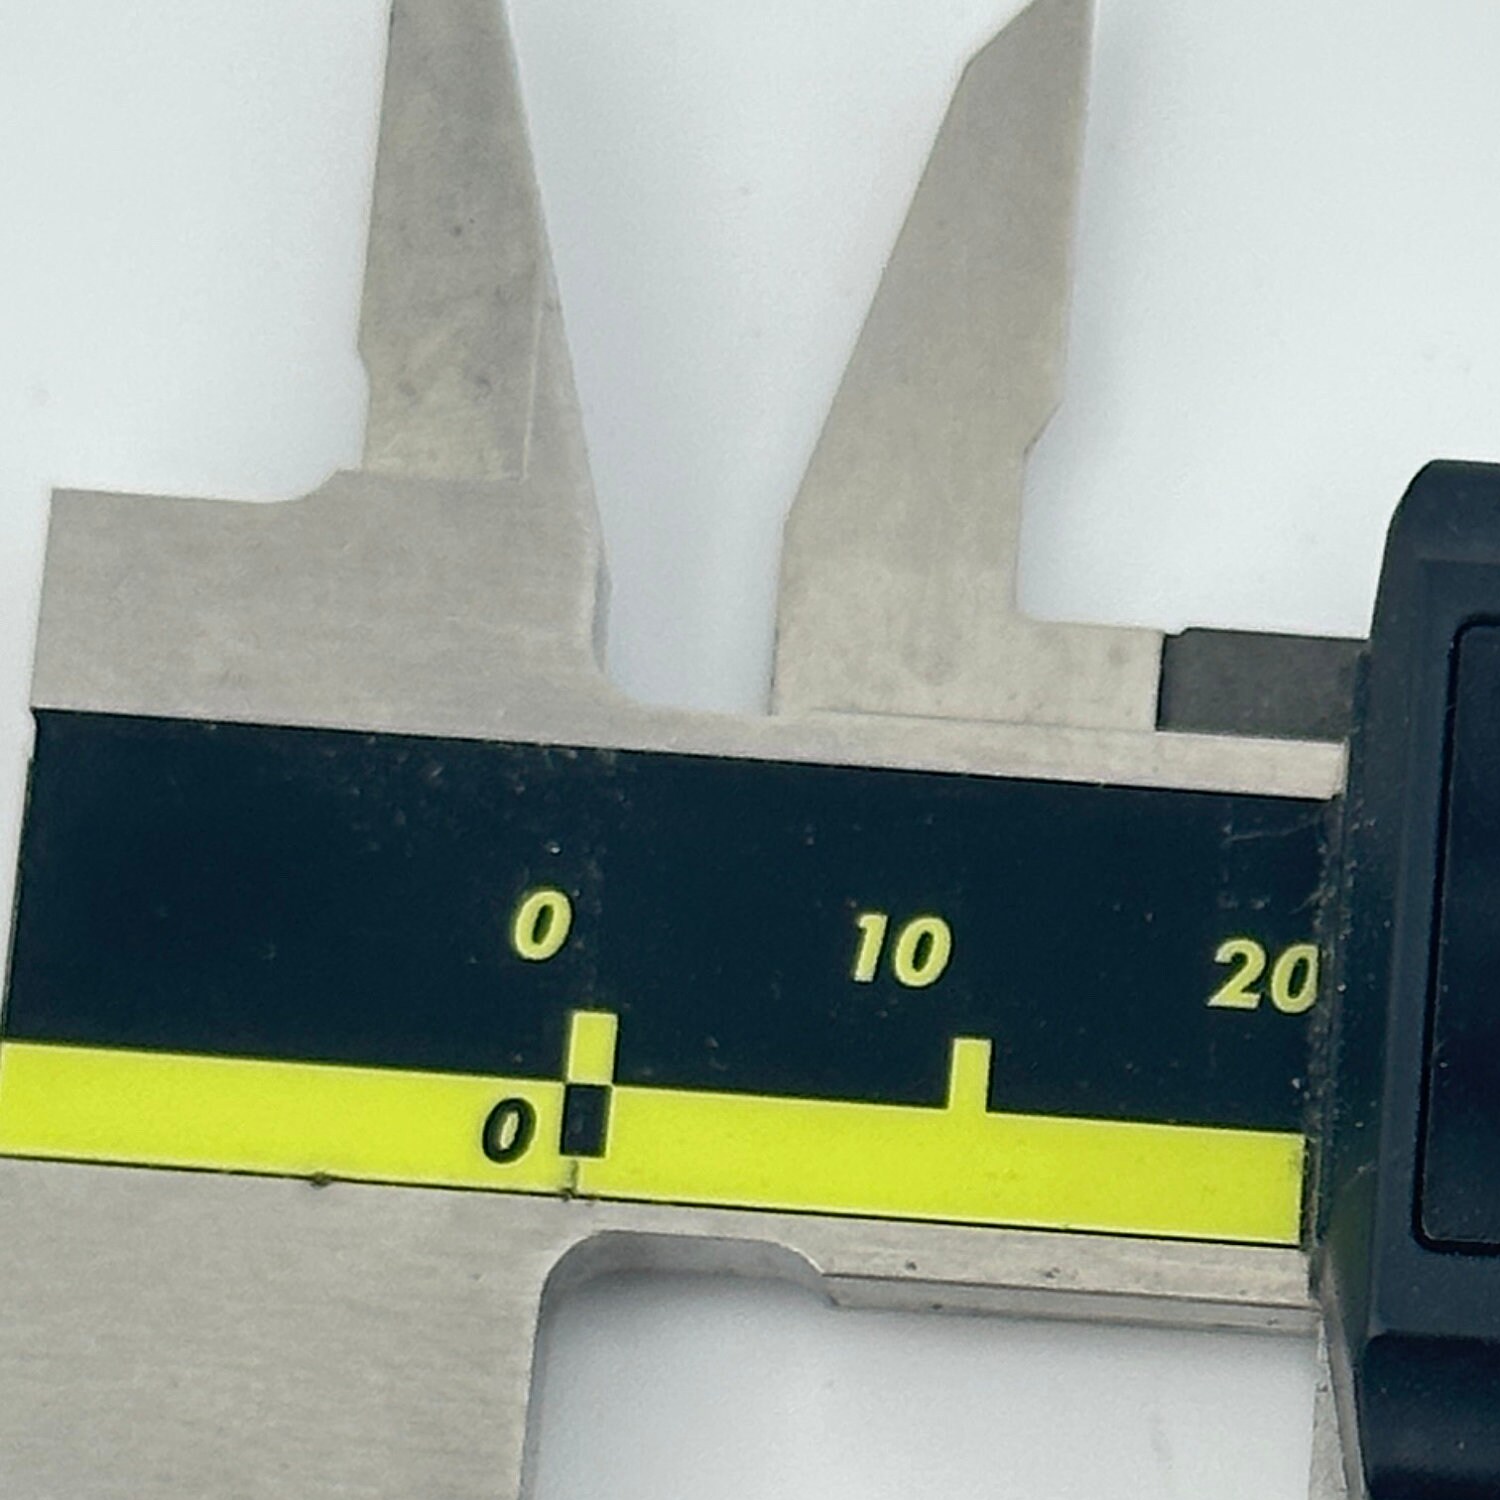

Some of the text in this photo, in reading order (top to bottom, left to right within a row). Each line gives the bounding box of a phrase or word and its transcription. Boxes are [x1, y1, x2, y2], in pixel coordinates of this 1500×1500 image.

[514, 889, 1320, 1014] 0 10 20
[482, 1098, 537, 1165] 0
